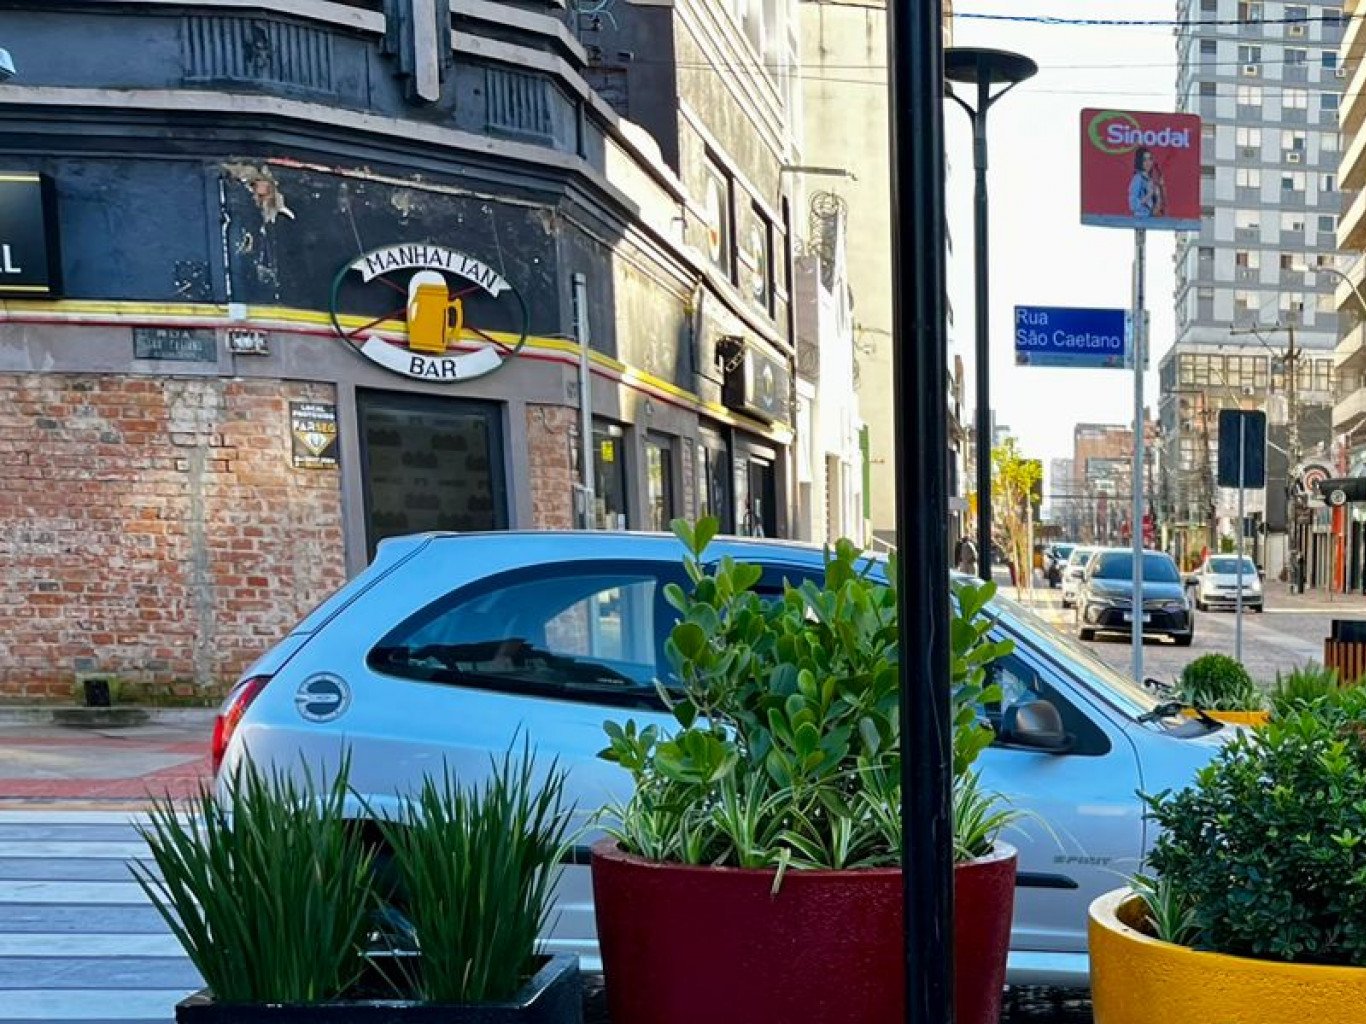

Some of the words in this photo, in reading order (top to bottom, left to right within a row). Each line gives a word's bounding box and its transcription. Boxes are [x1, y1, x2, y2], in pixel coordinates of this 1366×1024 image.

[1106, 124, 1190, 148] Sinodal
[0, 243, 22, 274] L
[365, 245, 500, 289] MANHATTAN
[1016, 308, 1049, 325] Rua
[1017, 328, 1048, 346] São
[1052, 330, 1121, 349] Caetano
[409, 356, 457, 378] BAR
